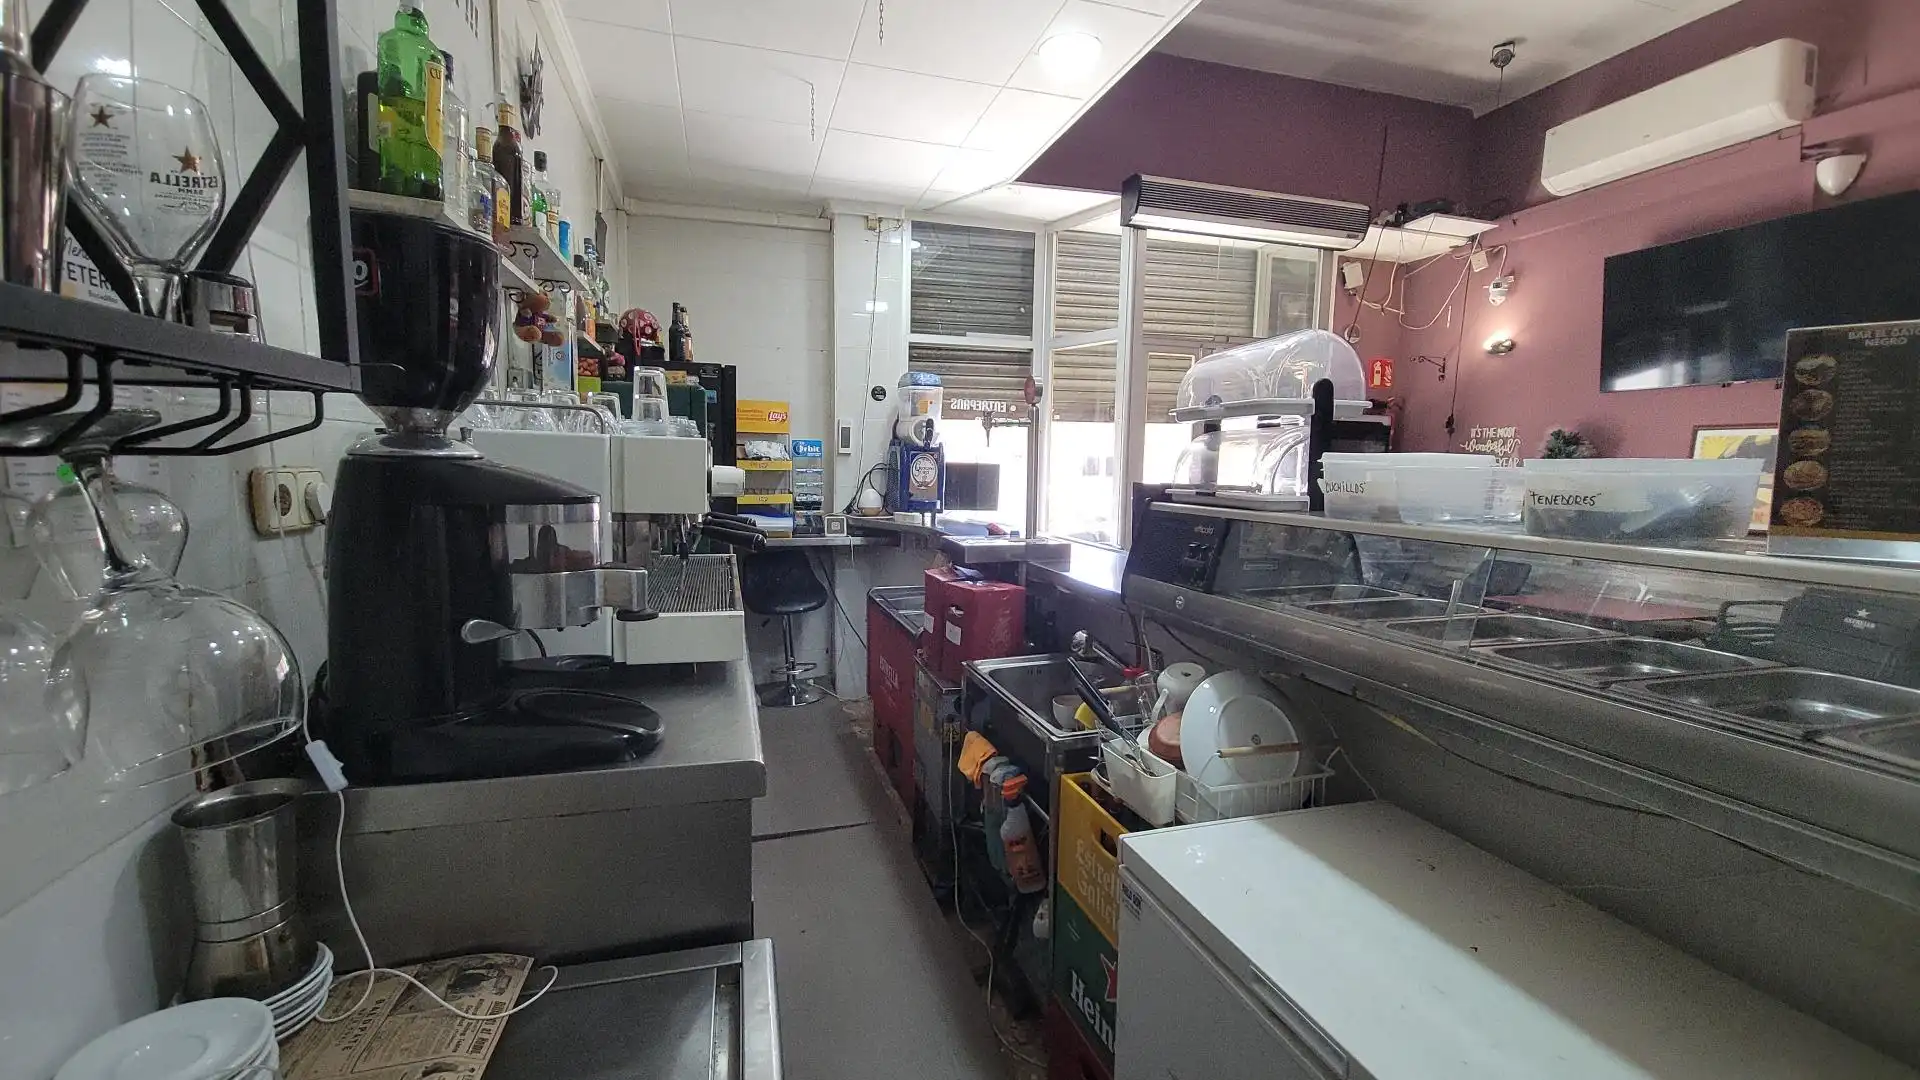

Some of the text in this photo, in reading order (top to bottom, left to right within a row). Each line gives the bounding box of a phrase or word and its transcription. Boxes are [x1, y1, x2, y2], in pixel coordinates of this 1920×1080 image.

[1864, 337, 1908, 347] NEGRO
[1482, 427, 1497, 438] THE
[1076, 838, 1121, 904] Estrell
[1077, 866, 1117, 932] Galici
[1069, 967, 1117, 1054] Hein
